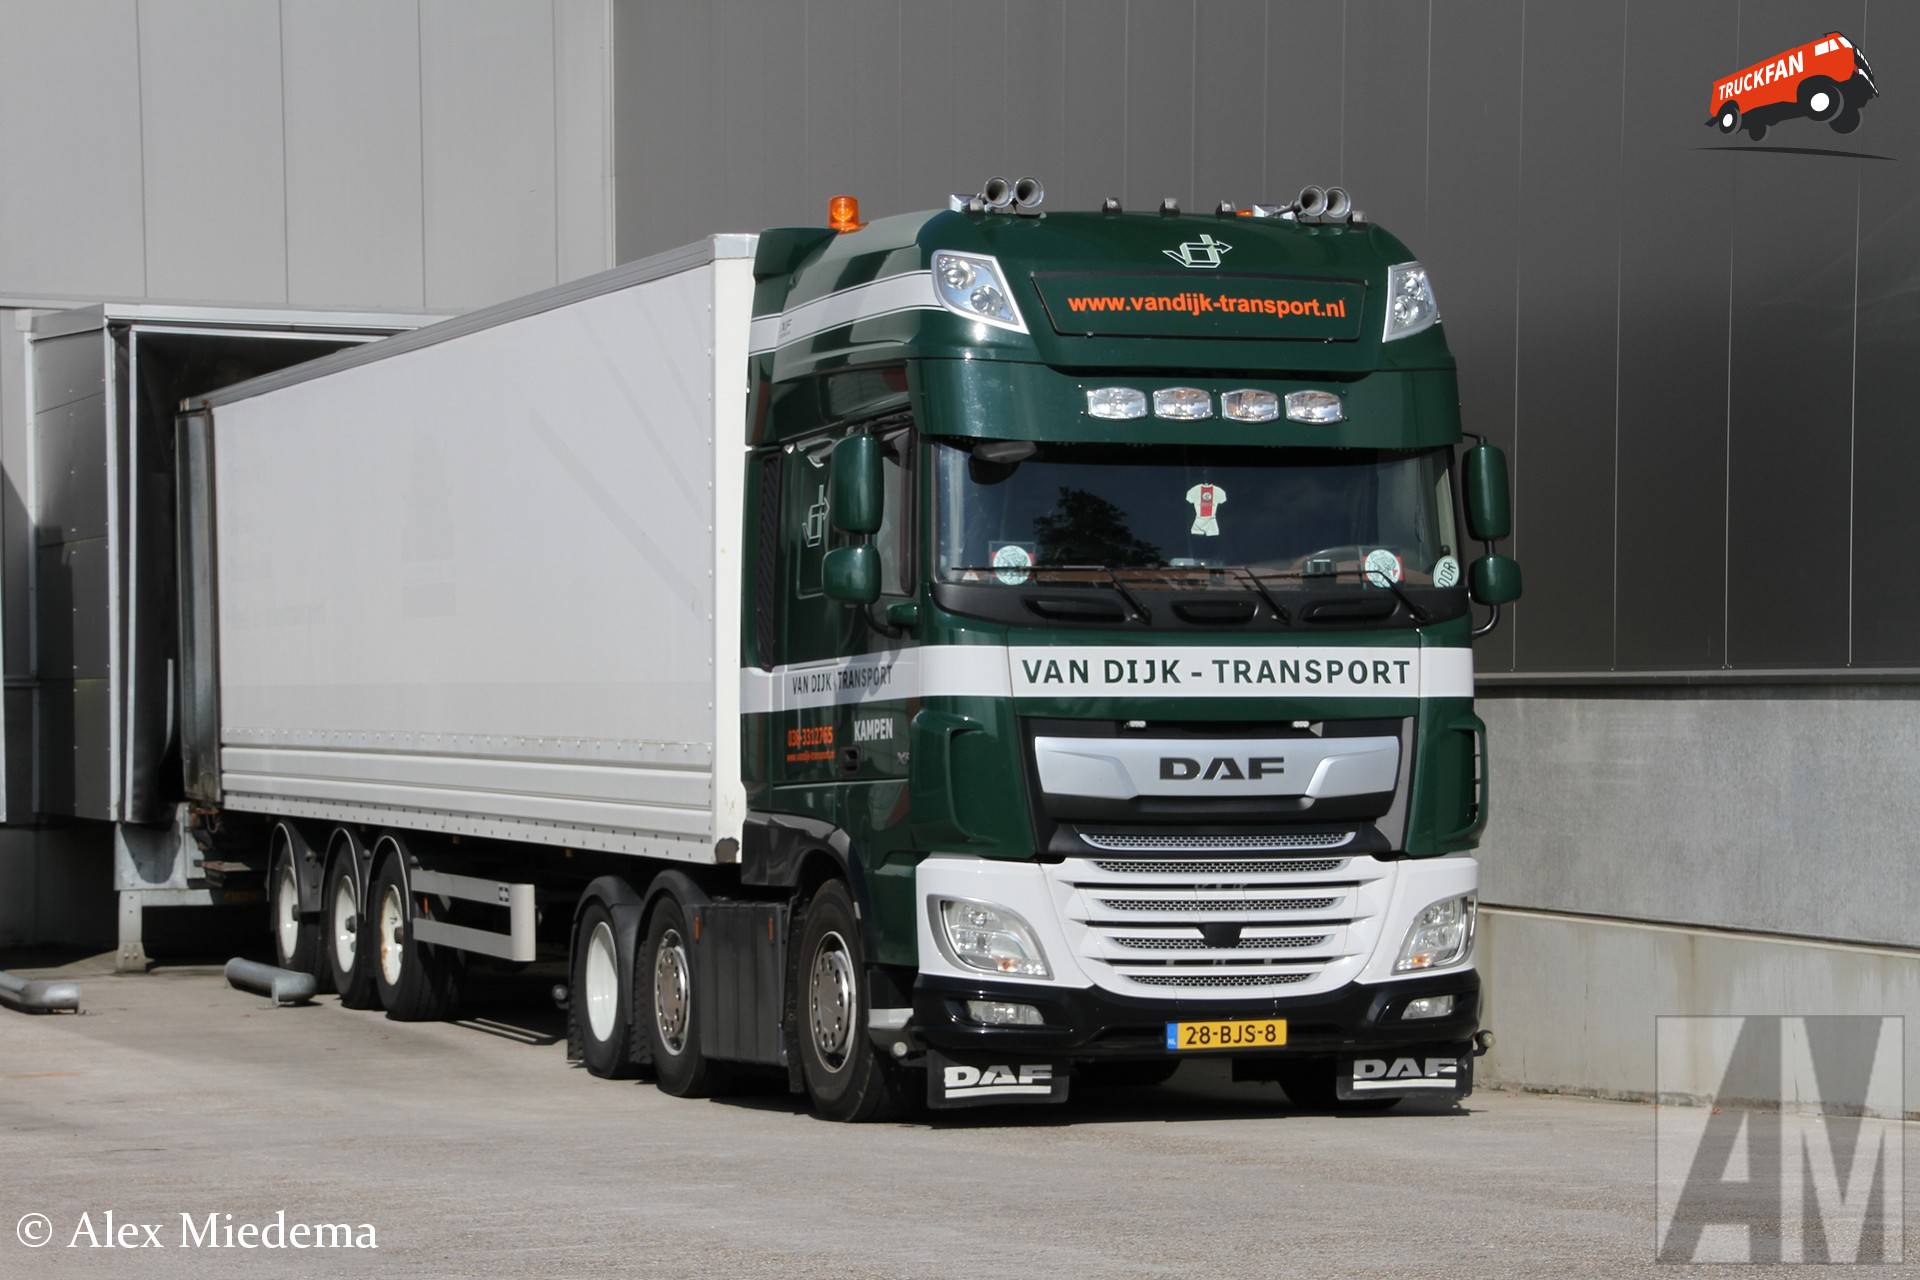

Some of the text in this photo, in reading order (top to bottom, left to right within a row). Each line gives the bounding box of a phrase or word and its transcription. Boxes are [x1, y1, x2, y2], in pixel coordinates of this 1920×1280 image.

[1068, 293, 1346, 318] www.vandijk-transport.nl
[1022, 659, 1089, 684] VAN
[1104, 659, 1181, 684] DIJK
[1212, 659, 1411, 684] TRANSPORT
[792, 675, 809, 695] VAN
[811, 673, 832, 692] DIJK
[854, 718, 893, 741] KAMPEN
[1159, 756, 1285, 780] DAF
[1186, 1024, 1276, 1045] 28-BJS-8
[944, 1064, 1052, 1088] DAF
[1353, 1058, 1457, 1080] DAF
